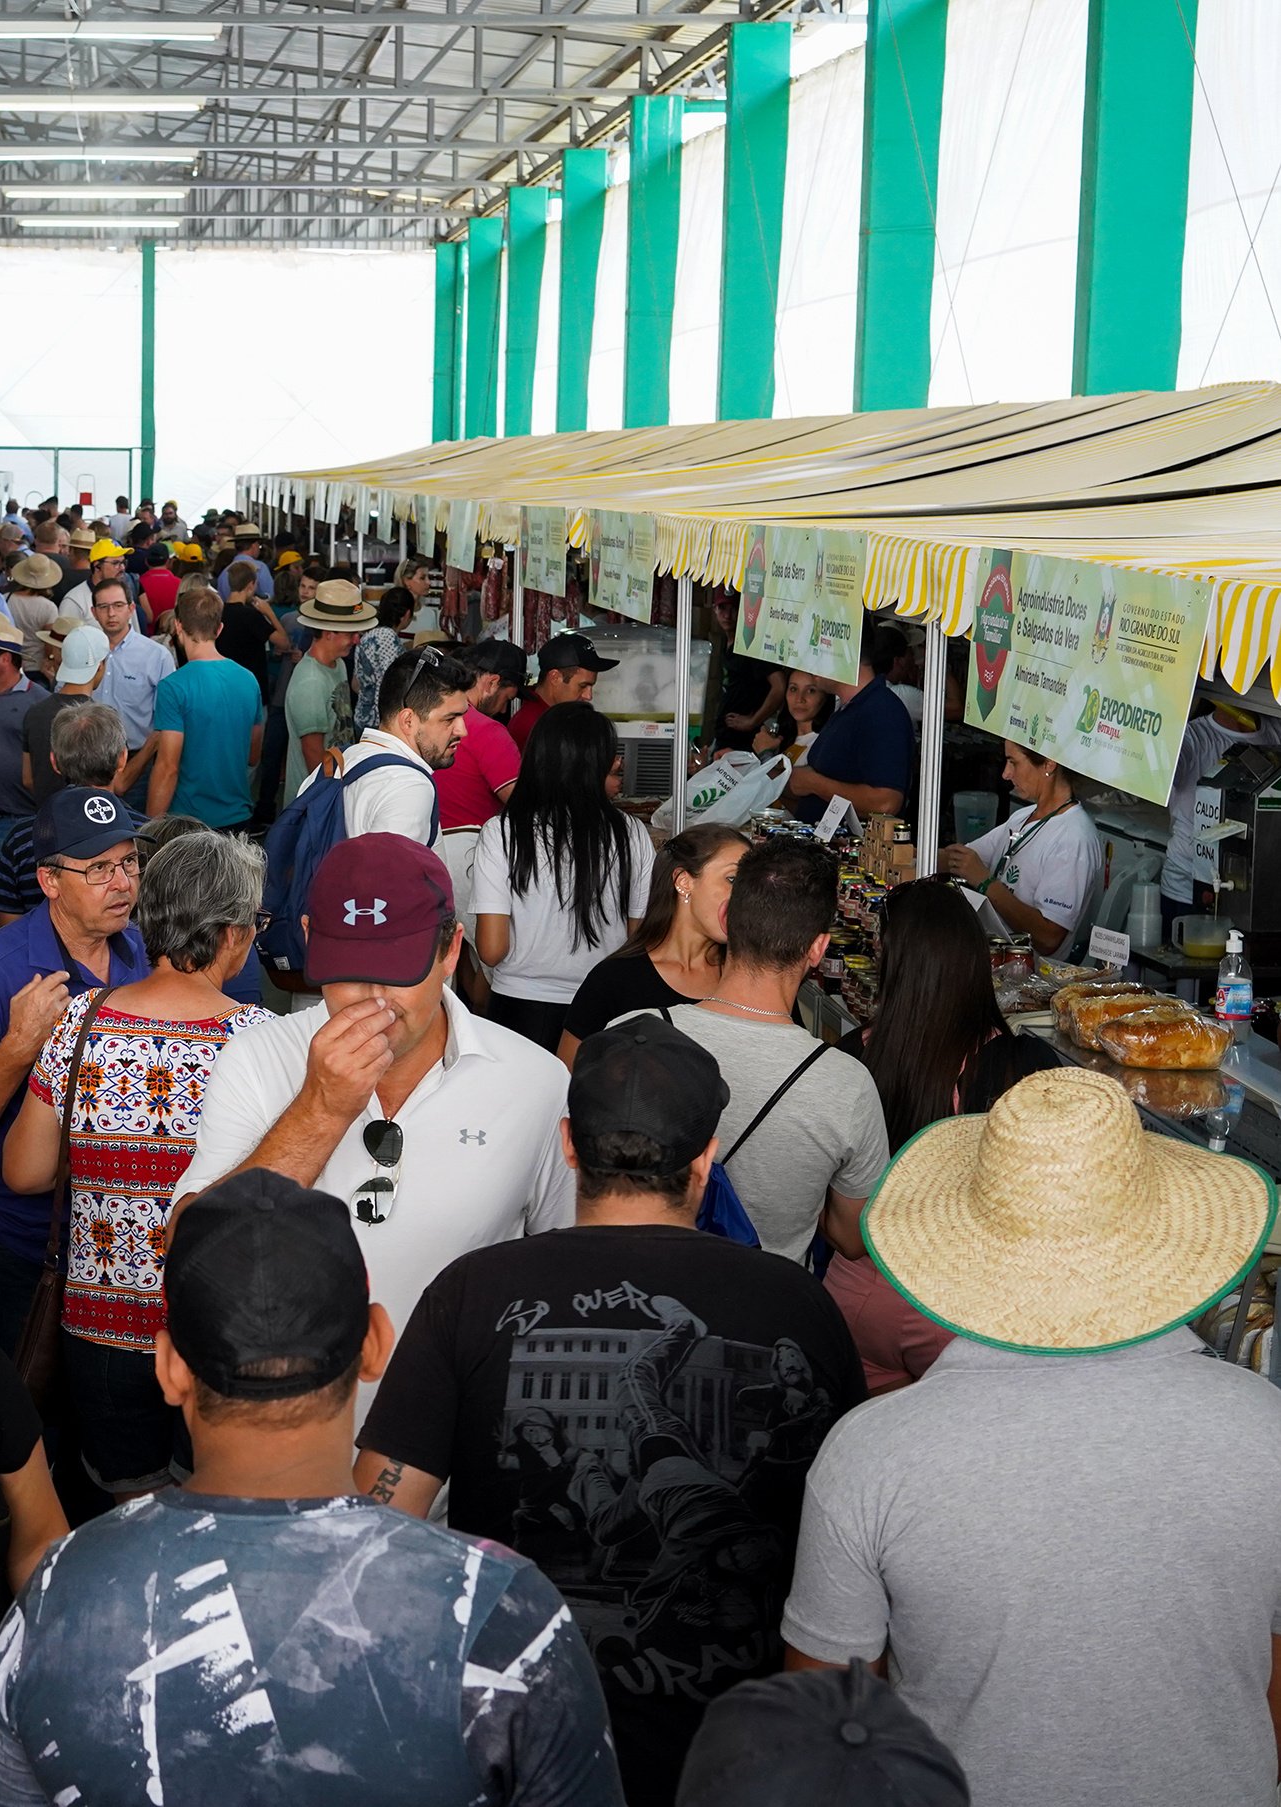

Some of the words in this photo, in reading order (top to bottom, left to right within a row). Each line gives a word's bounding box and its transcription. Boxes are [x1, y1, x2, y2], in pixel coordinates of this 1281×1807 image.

[772, 561, 783, 577] Casa
[784, 563, 791, 578] da
[792, 563, 805, 580] Serra
[1017, 587, 1065, 616] Agroindústria
[1067, 596, 1087, 621] Doces
[1123, 603, 1149, 617] GOVERNO
[1150, 609, 1159, 620] DO
[1160, 610, 1186, 625] ESTADO
[820, 619, 851, 641] EXPODIRETO
[1017, 624, 1022, 636] e
[1022, 617, 1053, 647] Salgados
[1055, 627, 1063, 646] da
[1063, 631, 1080, 651] Vera
[1119, 617, 1130, 633] RIO
[1131, 620, 1156, 639] GRANDE
[1157, 626, 1167, 641] DO
[1168, 628, 1180, 645] SUL
[1014, 664, 1039, 687] Almirante
[1040, 671, 1068, 698] Tamandaré
[1099, 696, 1162, 737] EXPODIRETO
[1196, 844, 1215, 862] CANA
[1050, 898, 1073, 910] Banrisul
